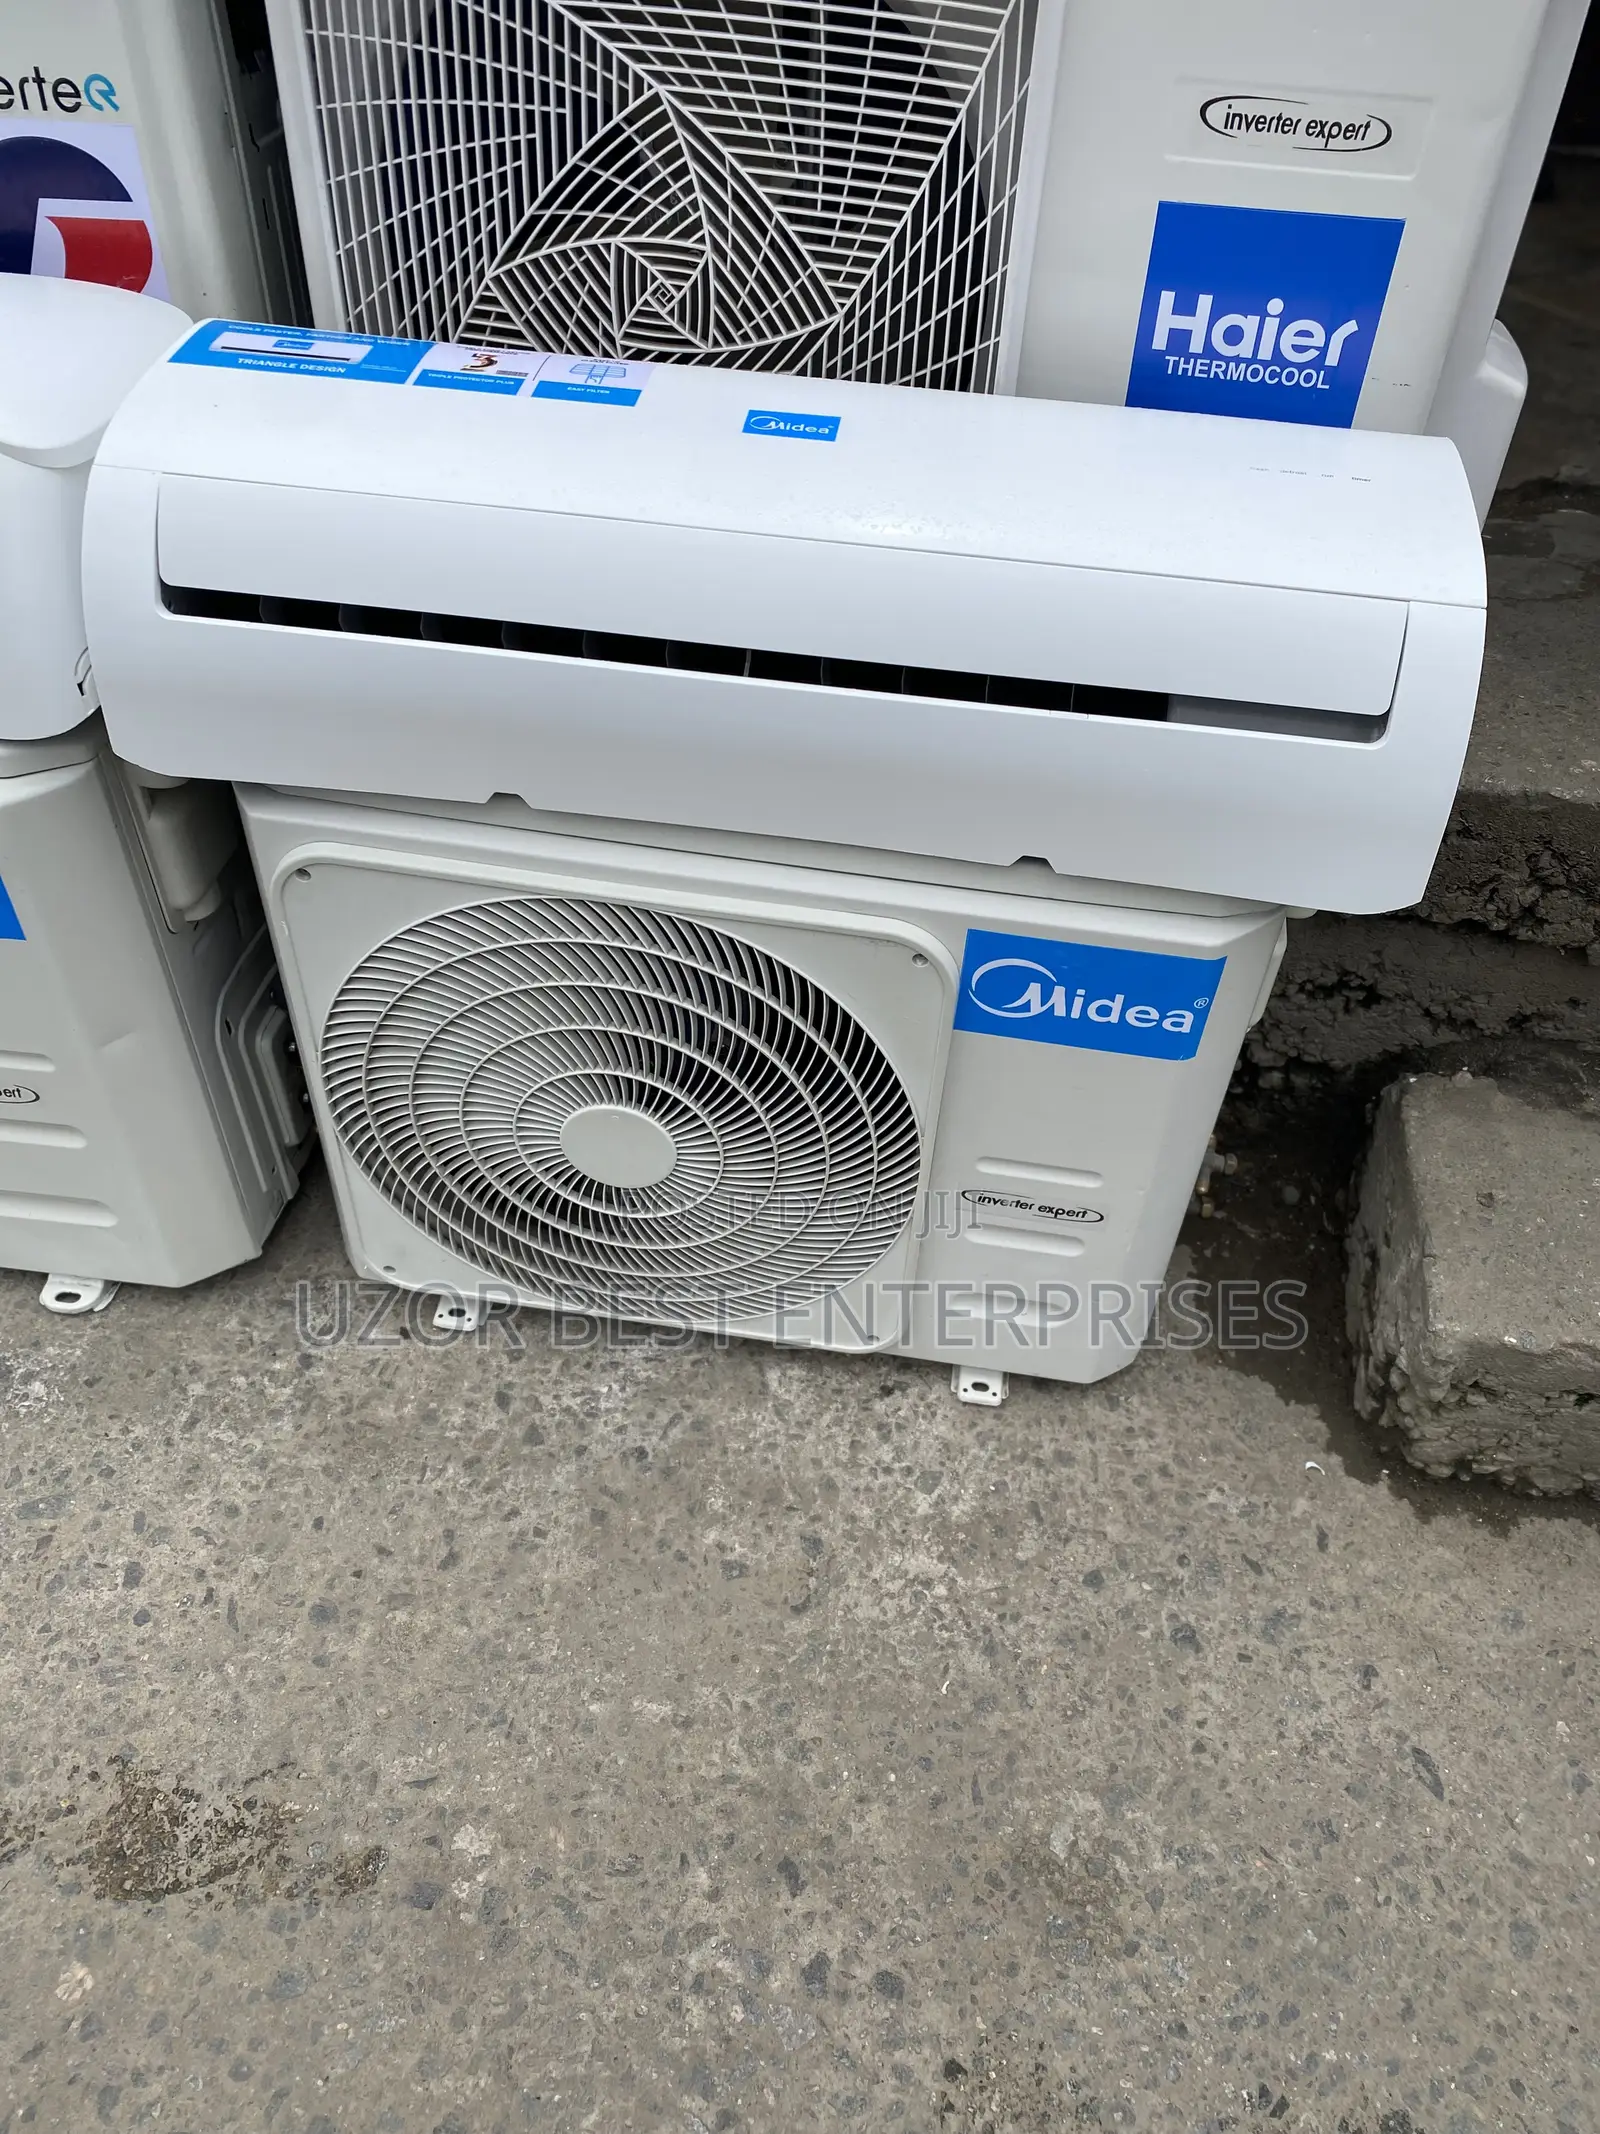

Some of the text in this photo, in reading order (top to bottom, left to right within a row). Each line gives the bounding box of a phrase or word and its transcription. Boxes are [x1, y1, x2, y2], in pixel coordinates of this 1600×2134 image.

[1223, 103, 1372, 148] inverter expert
[1152, 290, 1359, 367] Haier
[237, 357, 296, 370] TRIANGLE
[300, 363, 347, 374] DESIGN
[1164, 356, 1330, 389] THERMOCOOL
[750, 416, 829, 434] Midea
[978, 1192, 1088, 1219] inverter expert
